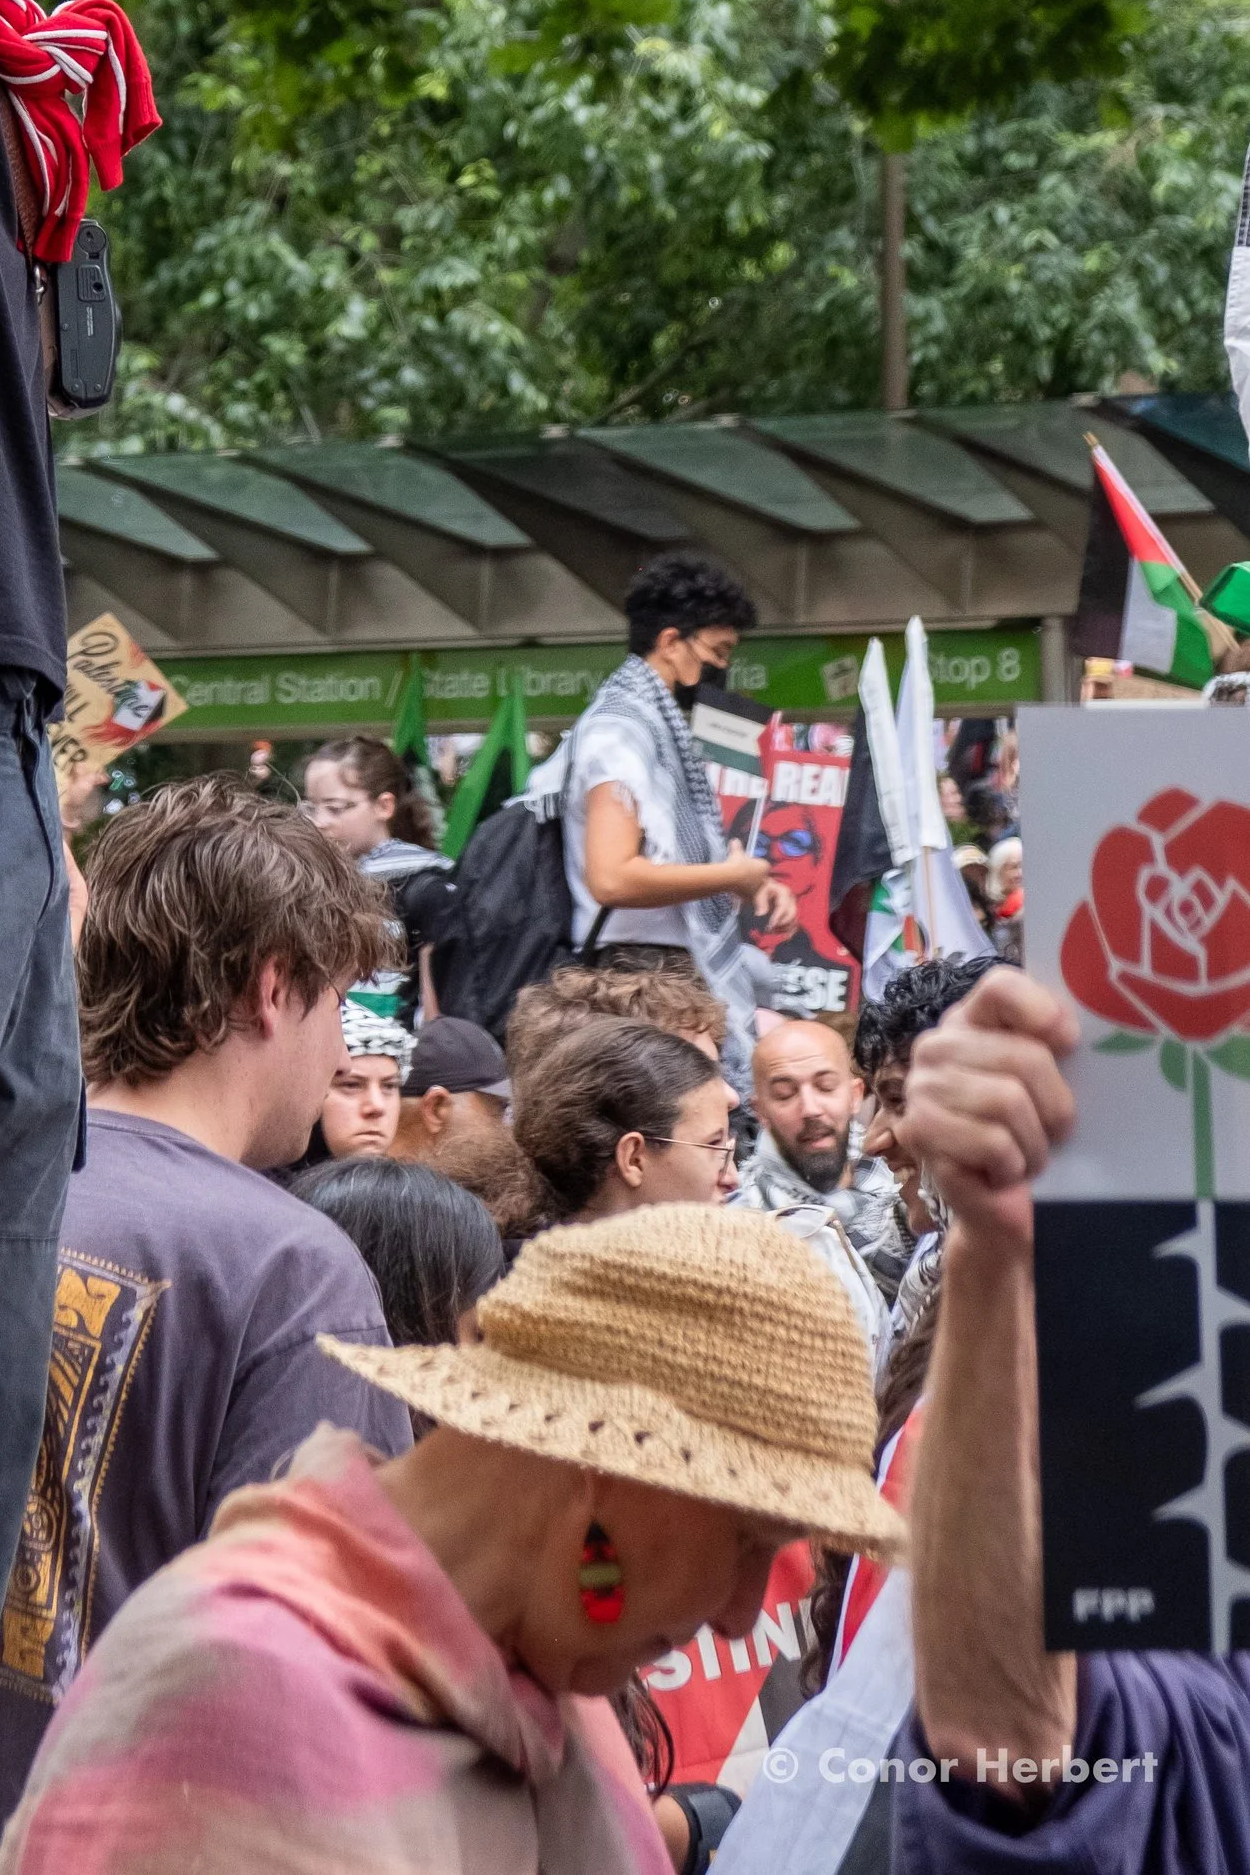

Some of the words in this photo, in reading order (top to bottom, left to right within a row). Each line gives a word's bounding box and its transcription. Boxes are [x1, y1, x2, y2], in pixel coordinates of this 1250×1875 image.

[274, 670, 383, 705] Station
[497, 665, 602, 703] Lbrary
[997, 646, 1022, 682] 8
[1072, 1586, 1155, 1624] FPP
